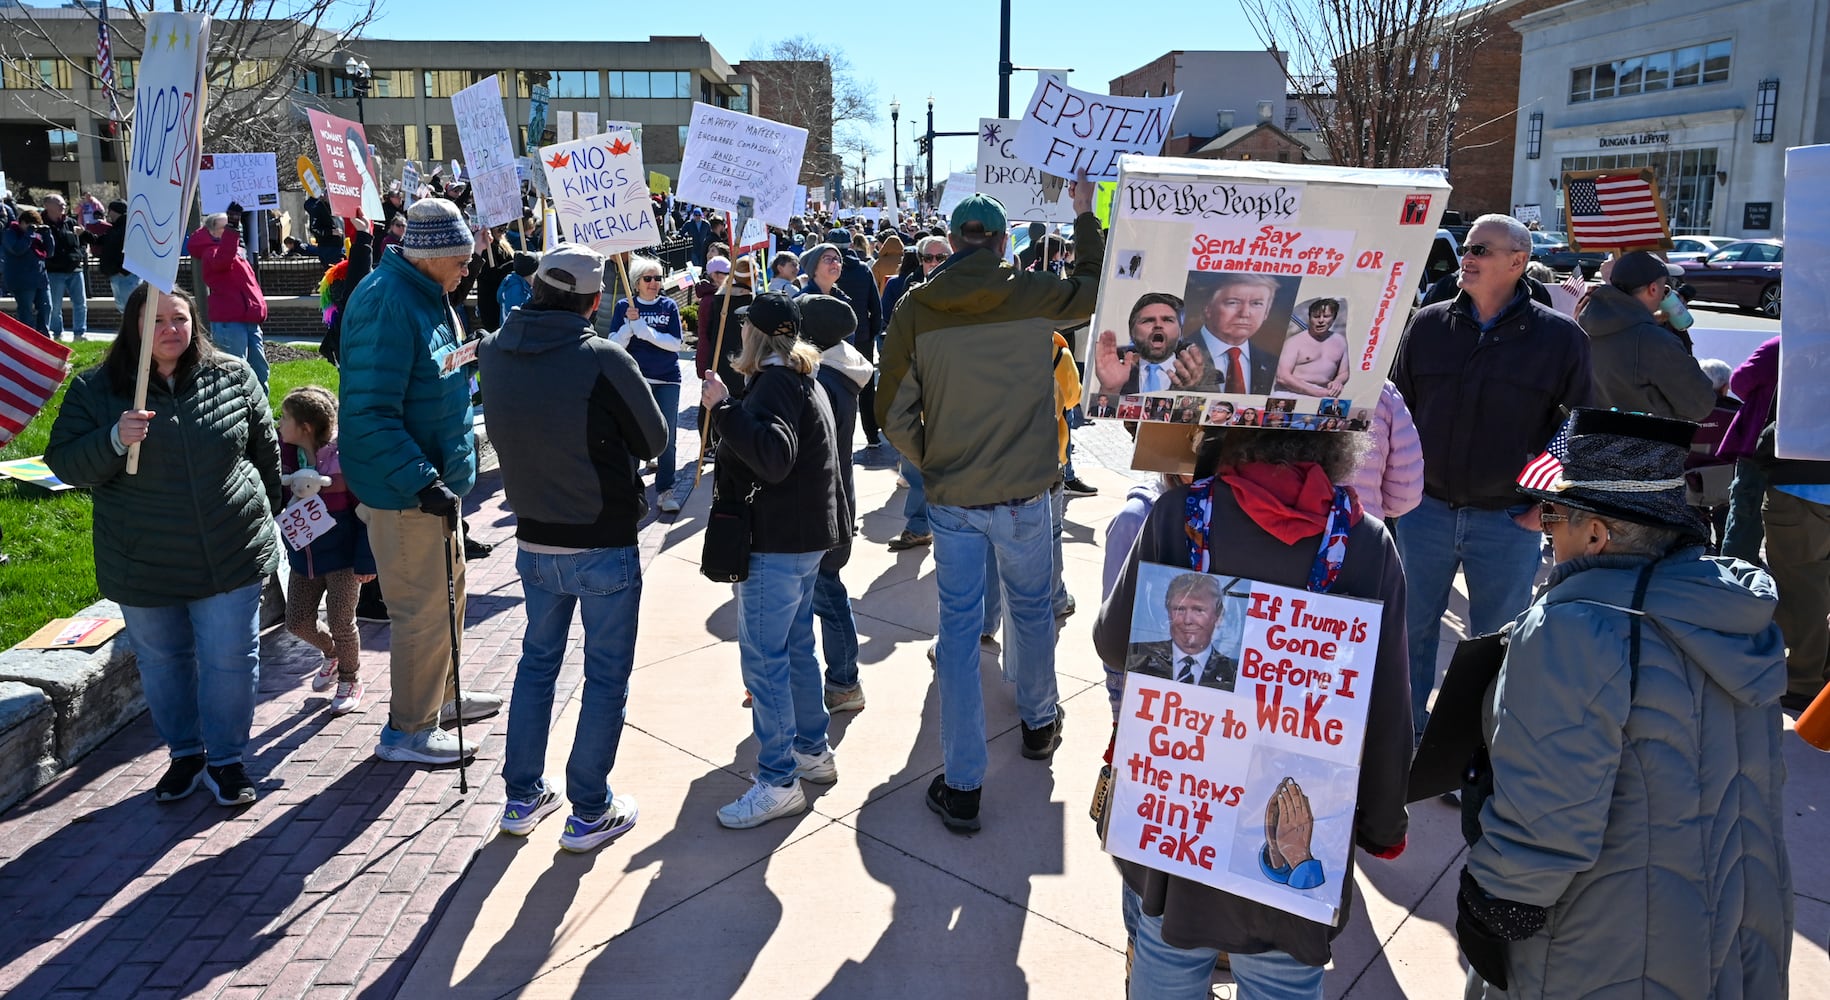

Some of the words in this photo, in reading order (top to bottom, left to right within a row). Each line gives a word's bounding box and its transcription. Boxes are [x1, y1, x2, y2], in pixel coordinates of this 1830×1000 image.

[1031, 79, 1174, 146] EPSTEIN
[326, 119, 331, 129] A
[700, 114, 739, 130] EMPATHY
[745, 125, 787, 143] MATTERS!
[320, 130, 343, 144] WOMAN'S
[1600, 136, 1629, 148] DUNGAN
[1630, 135, 1637, 145] &
[326, 144, 345, 158] PLACE
[571, 146, 605, 173] NO
[712, 150, 741, 163] HANDS
[216, 155, 268, 170] DEMOCRACY
[216, 183, 229, 195] IN
[231, 176, 276, 192] SILENCE!
[229, 169, 256, 180] DIES
[336, 171, 347, 182] THE
[563, 168, 628, 198] KINGS
[698, 172, 732, 188] CANADA
[328, 183, 361, 198] RESISTANCE
[710, 192, 739, 206] GREENL
[586, 193, 616, 213] IN
[1125, 184, 1167, 214] We
[1202, 184, 1298, 223] People
[574, 210, 653, 244] AMERICA
[1259, 225, 1302, 249] Say
[1191, 234, 1246, 256] Send
[1249, 239, 1293, 260] them
[1299, 246, 1323, 260] off
[1325, 245, 1345, 262] to
[1196, 254, 1303, 275] Guantanamo
[1307, 260, 1341, 277] Bay
[1356, 251, 1384, 270] OR
[640, 315, 670, 326] KINGS
[303, 499, 323, 521] NO
[1246, 592, 1282, 621] If
[1291, 599, 1348, 642] Trump
[1349, 617, 1368, 643] is
[1266, 625, 1338, 661] Gone
[1242, 648, 1332, 690] Before
[1335, 668, 1359, 699] I
[1135, 687, 1160, 723] I
[1161, 691, 1215, 736] Pray
[1221, 709, 1247, 740] to
[1149, 726, 1206, 762] God
[1127, 753, 1174, 791] the
[1180, 772, 1245, 807] news
[1137, 793, 1214, 835] ain't
